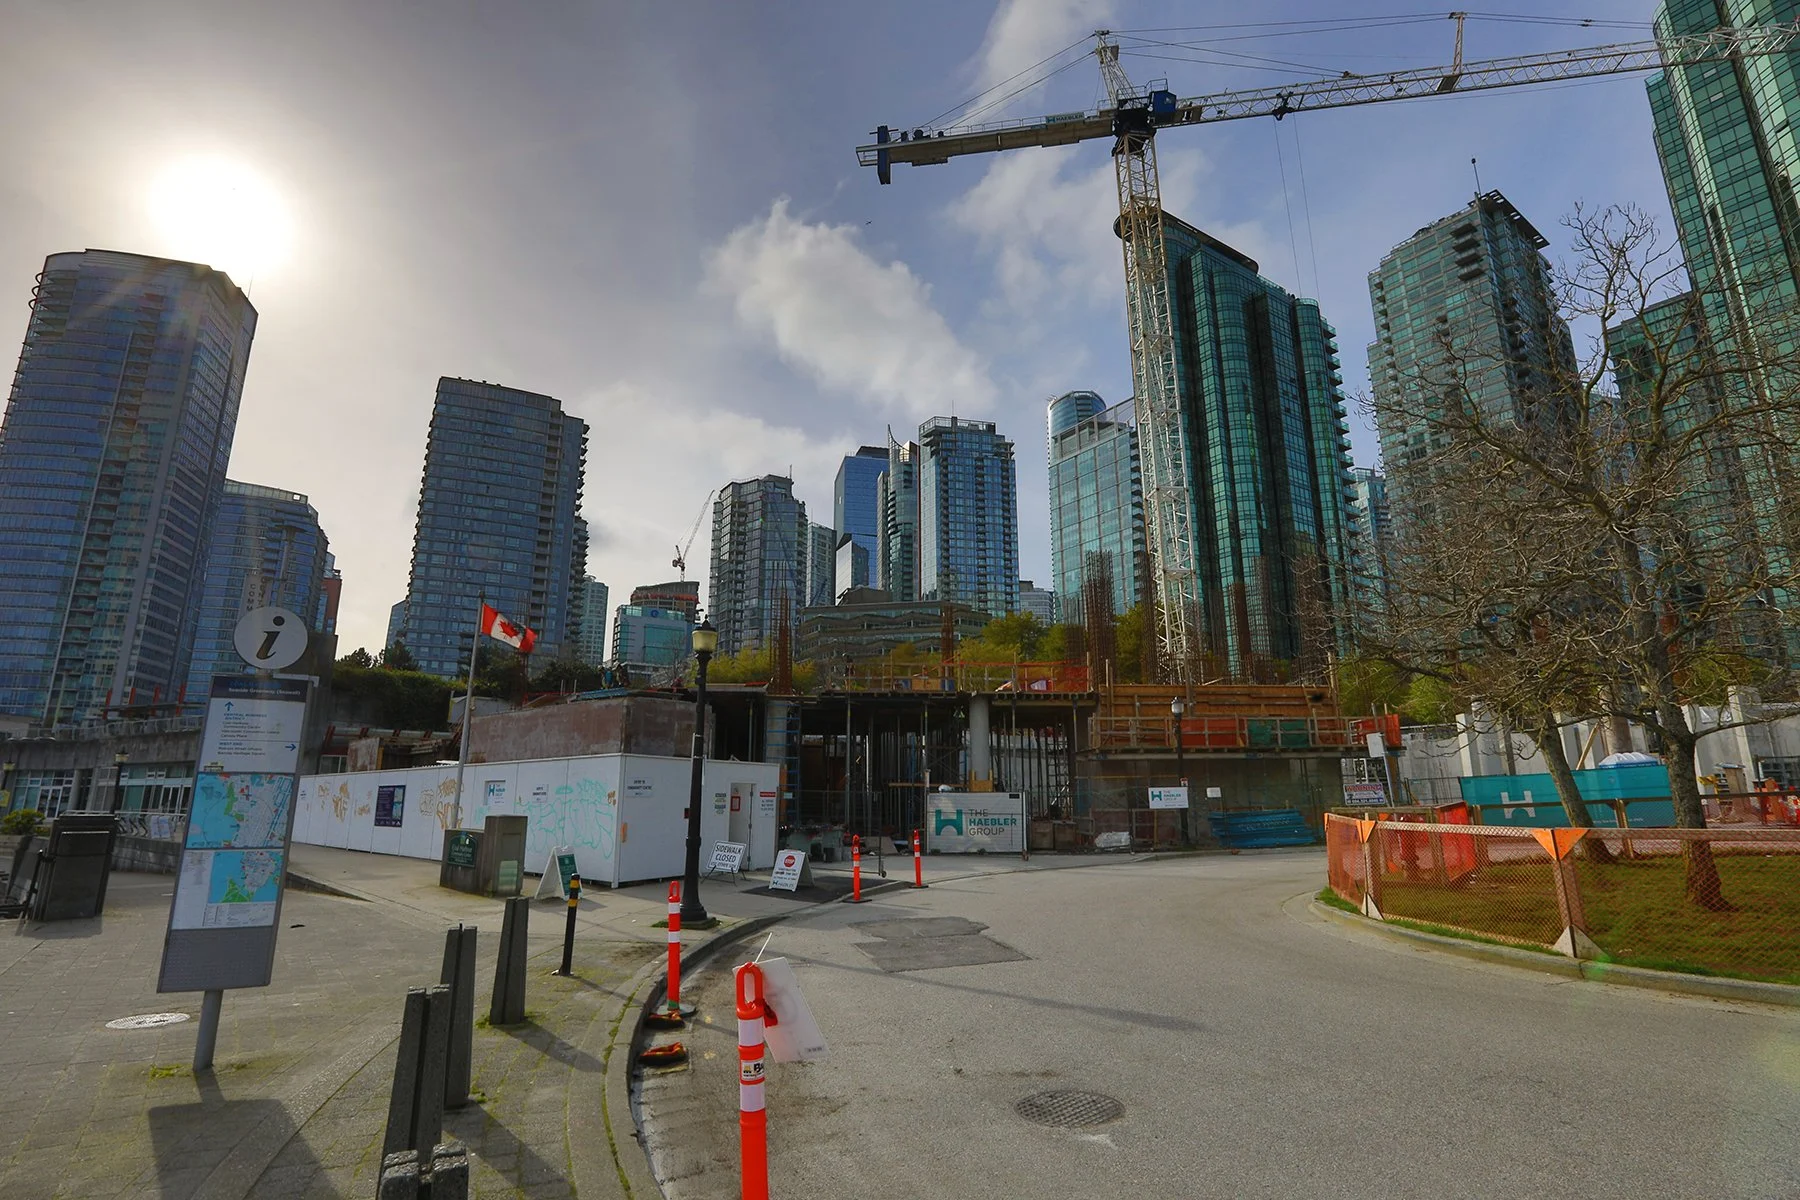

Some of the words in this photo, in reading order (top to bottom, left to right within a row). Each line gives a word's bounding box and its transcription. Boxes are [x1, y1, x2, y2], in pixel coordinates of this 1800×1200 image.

[968, 808, 989, 817] THE
[968, 817, 1018, 827] HAEBLER
[968, 826, 1005, 836] GROUP
[715, 844, 742, 854] SIDEWALK
[715, 853, 736, 862] CLOSED
